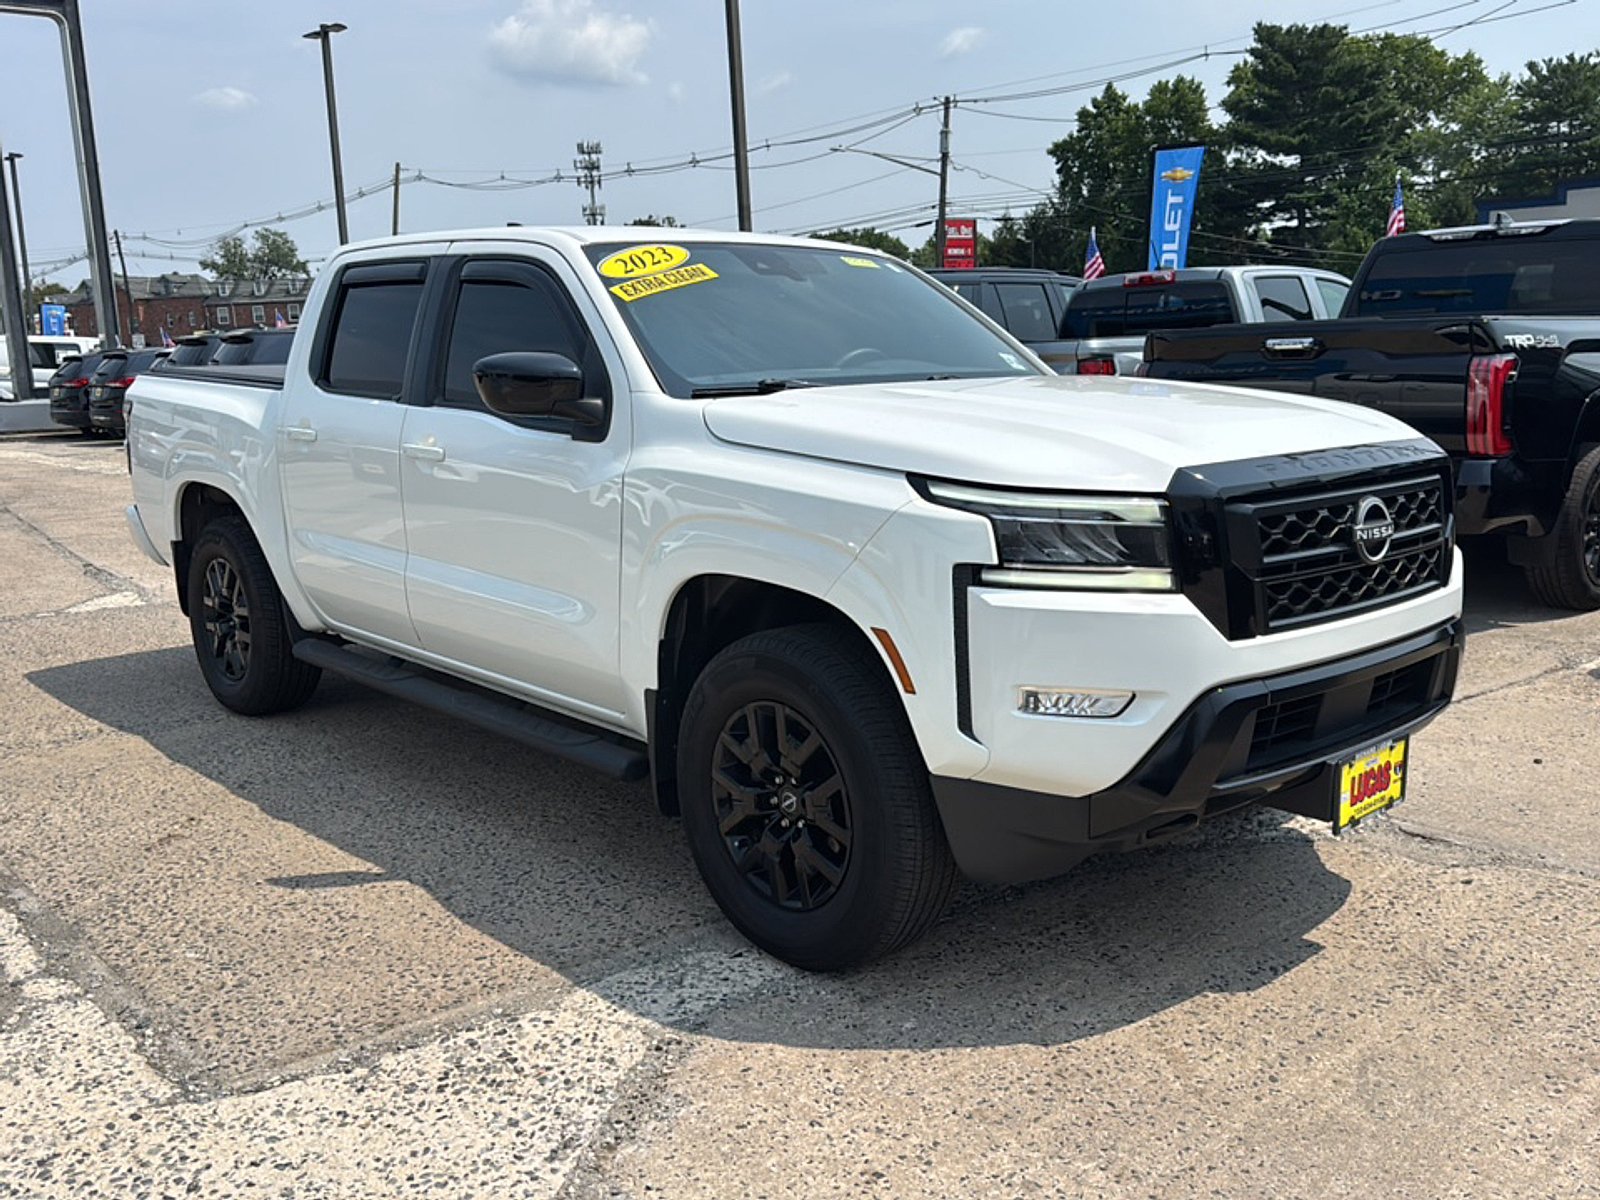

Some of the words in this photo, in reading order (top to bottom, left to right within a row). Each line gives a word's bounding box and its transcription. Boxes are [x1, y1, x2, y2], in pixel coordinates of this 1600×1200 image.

[615, 247, 673, 274] 2023
[620, 276, 665, 298] EXTRA
[663, 266, 708, 285] CLEAN
[1350, 760, 1391, 807] LUCAS
